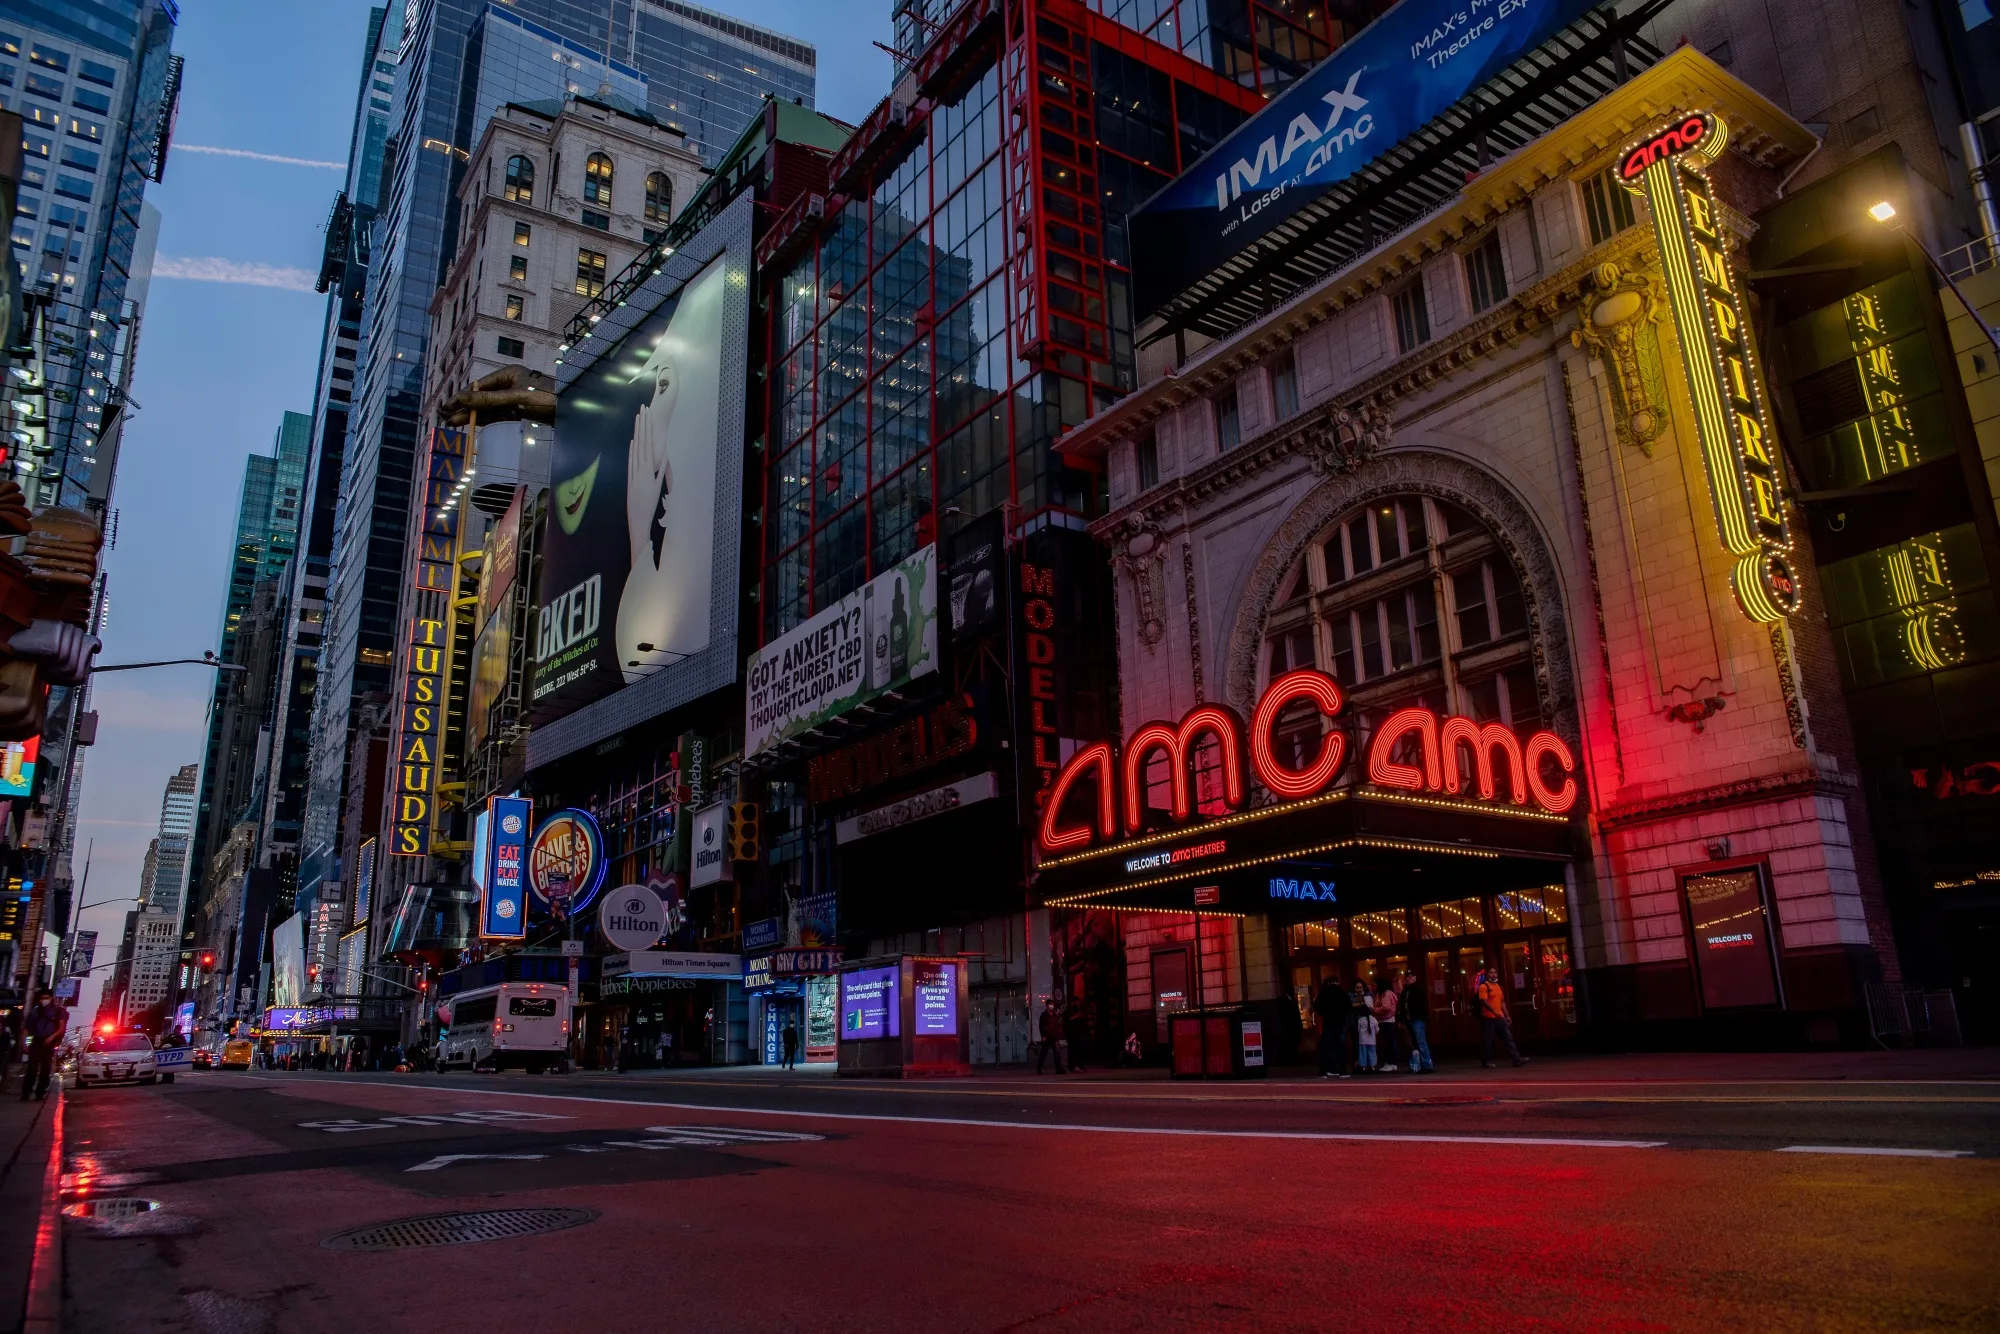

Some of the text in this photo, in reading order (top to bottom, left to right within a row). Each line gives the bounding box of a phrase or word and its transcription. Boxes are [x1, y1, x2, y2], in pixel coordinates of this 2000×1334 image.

[1411, 9, 1467, 60] IMAX's
[1427, 16, 1494, 69] Theatre
[1216, 66, 1370, 212] IMAX
[1221, 218, 1239, 237] with
[1240, 179, 1288, 222] Laser
[1291, 174, 1302, 188] AT
[1687, 188, 1781, 526] EMPIRE
[424, 429, 462, 589] MADAME
[563, 646, 583, 663] Witches
[751, 655, 779, 692] GOT
[782, 606, 861, 675] ANXIETY?
[556, 674, 566, 688] 222
[566, 668, 579, 682] West
[590, 659, 598, 670] St.
[751, 687, 770, 711] TRY
[771, 675, 790, 700] THE
[793, 650, 835, 689] PUREST
[838, 636, 861, 664] CBD
[751, 657, 862, 731] THOUGHTCLOUD.NET
[399, 619, 443, 854] TUSSAUD'S
[684, 740, 703, 812] Applebee's
[498, 845, 520, 860] EAT.
[537, 831, 586, 870] DAVE &
[697, 849, 722, 869] Hilton
[1126, 855, 1160, 873] WELCOME
[1161, 853, 1171, 866] TO
[1191, 841, 1227, 859] THEATRES
[497, 868, 519, 879] PLAY.
[498, 860, 520, 869] DRINK.
[497, 878, 519, 887] WATCH.
[1269, 878, 1337, 902] IMAX
[609, 915, 659, 931] Hilton
[750, 923, 769, 935] MONEY
[312, 903, 330, 994] AMSTERDAM
[746, 932, 776, 946] EXCHANGE
[1708, 933, 1753, 944] WELCOME TO
[662, 958, 730, 969] Hilton Times Square
[750, 957, 769, 973] MONEY
[798, 952, 845, 973] GIFTS
[745, 972, 776, 989] EXCHANG
[854, 984, 863, 992] only
[863, 982, 872, 990] card
[872, 981, 881, 989] that
[882, 980, 893, 990] gives
[935, 972, 948, 980] only
[854, 992, 866, 1000] karma
[867, 991, 881, 1000] points.
[921, 987, 950, 995] gives you
[925, 1002, 947, 1010] points.
[768, 1002, 777, 1063] CHANGE
[156, 1051, 184, 1063] NYPD
